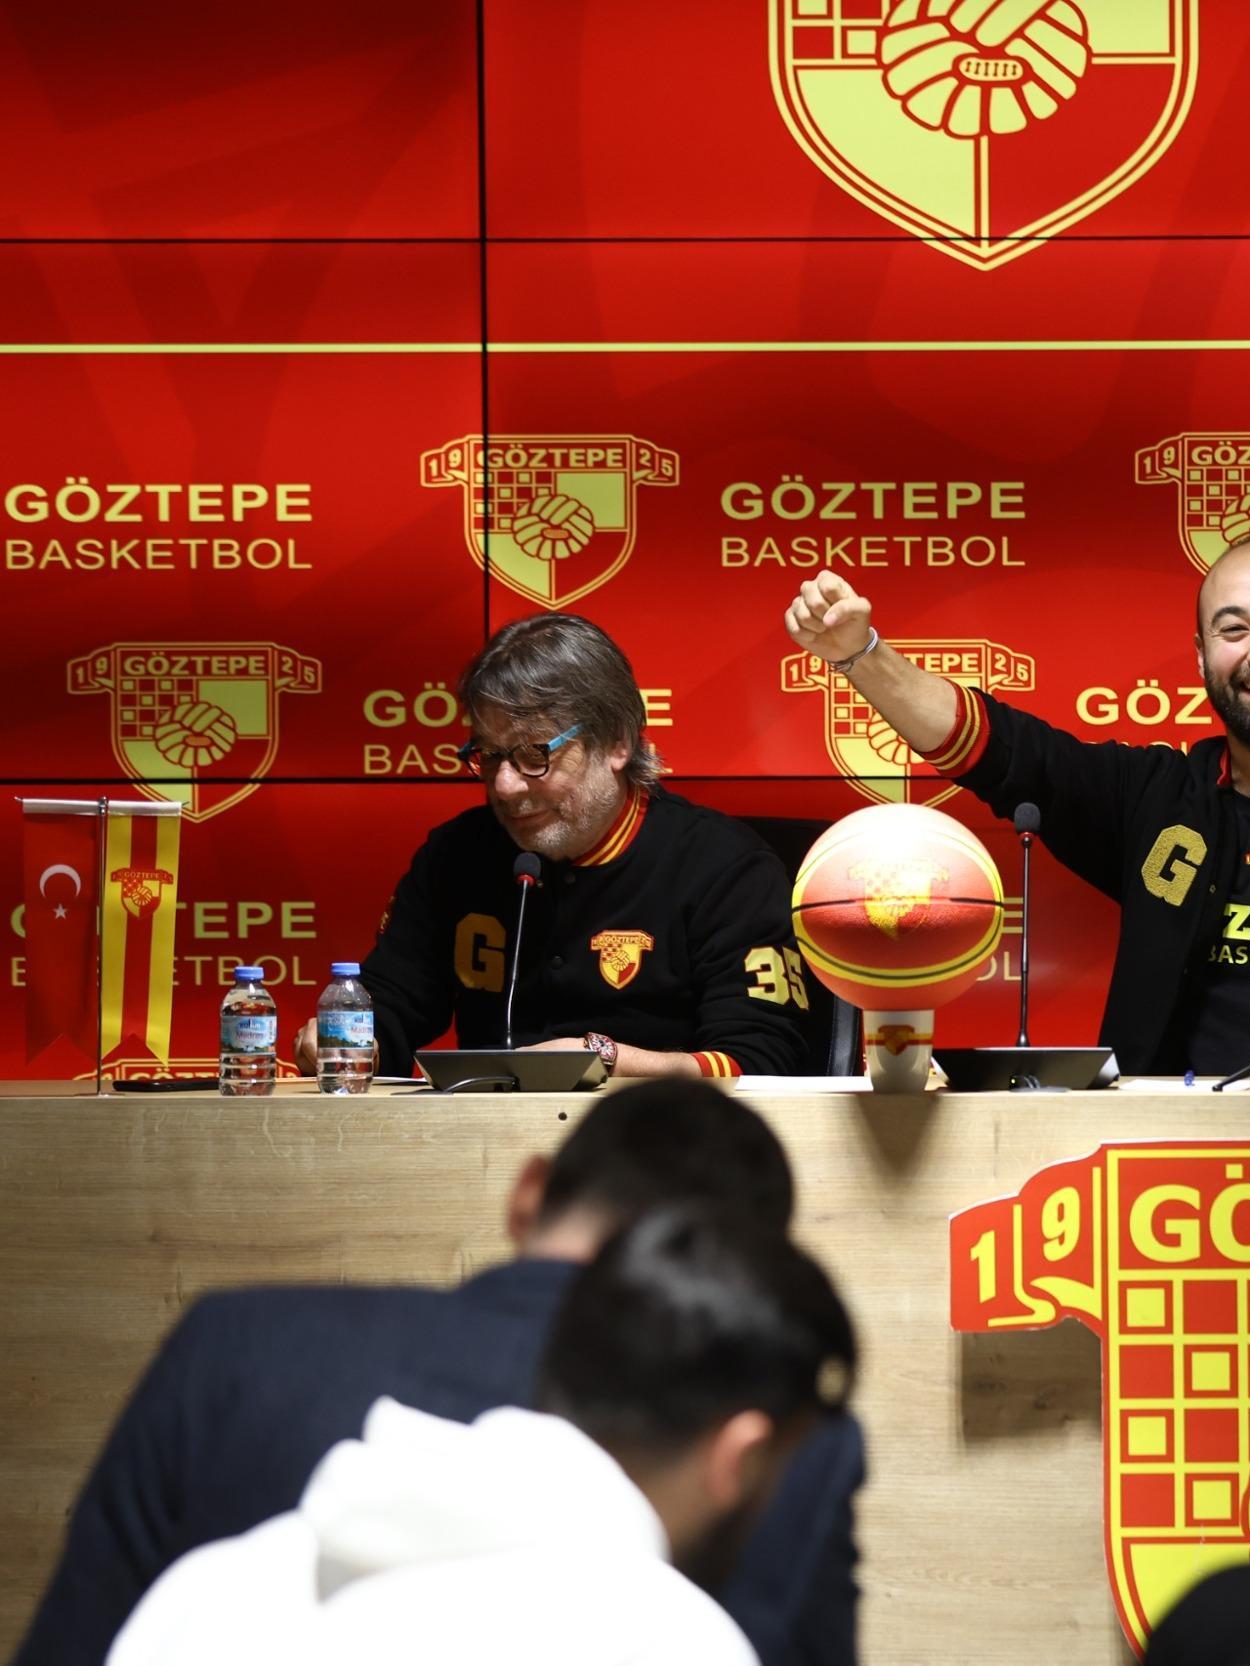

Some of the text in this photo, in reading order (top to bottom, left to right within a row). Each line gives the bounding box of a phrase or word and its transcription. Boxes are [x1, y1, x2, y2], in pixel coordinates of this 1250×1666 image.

[477, 443, 623, 467] GÖZTEPE
[5, 477, 312, 522] GÖZTEPE
[721, 475, 1025, 520] GÖZTEPE
[6, 538, 312, 570] BASKETBOL
[721, 536, 1025, 568] BASKETBOL
[124, 651, 265, 675] GÖZTEPE
[907, 653, 979, 673] TEPE
[1140, 824, 1208, 907] G
[454, 912, 507, 992] G
[743, 946, 810, 1010] 35
